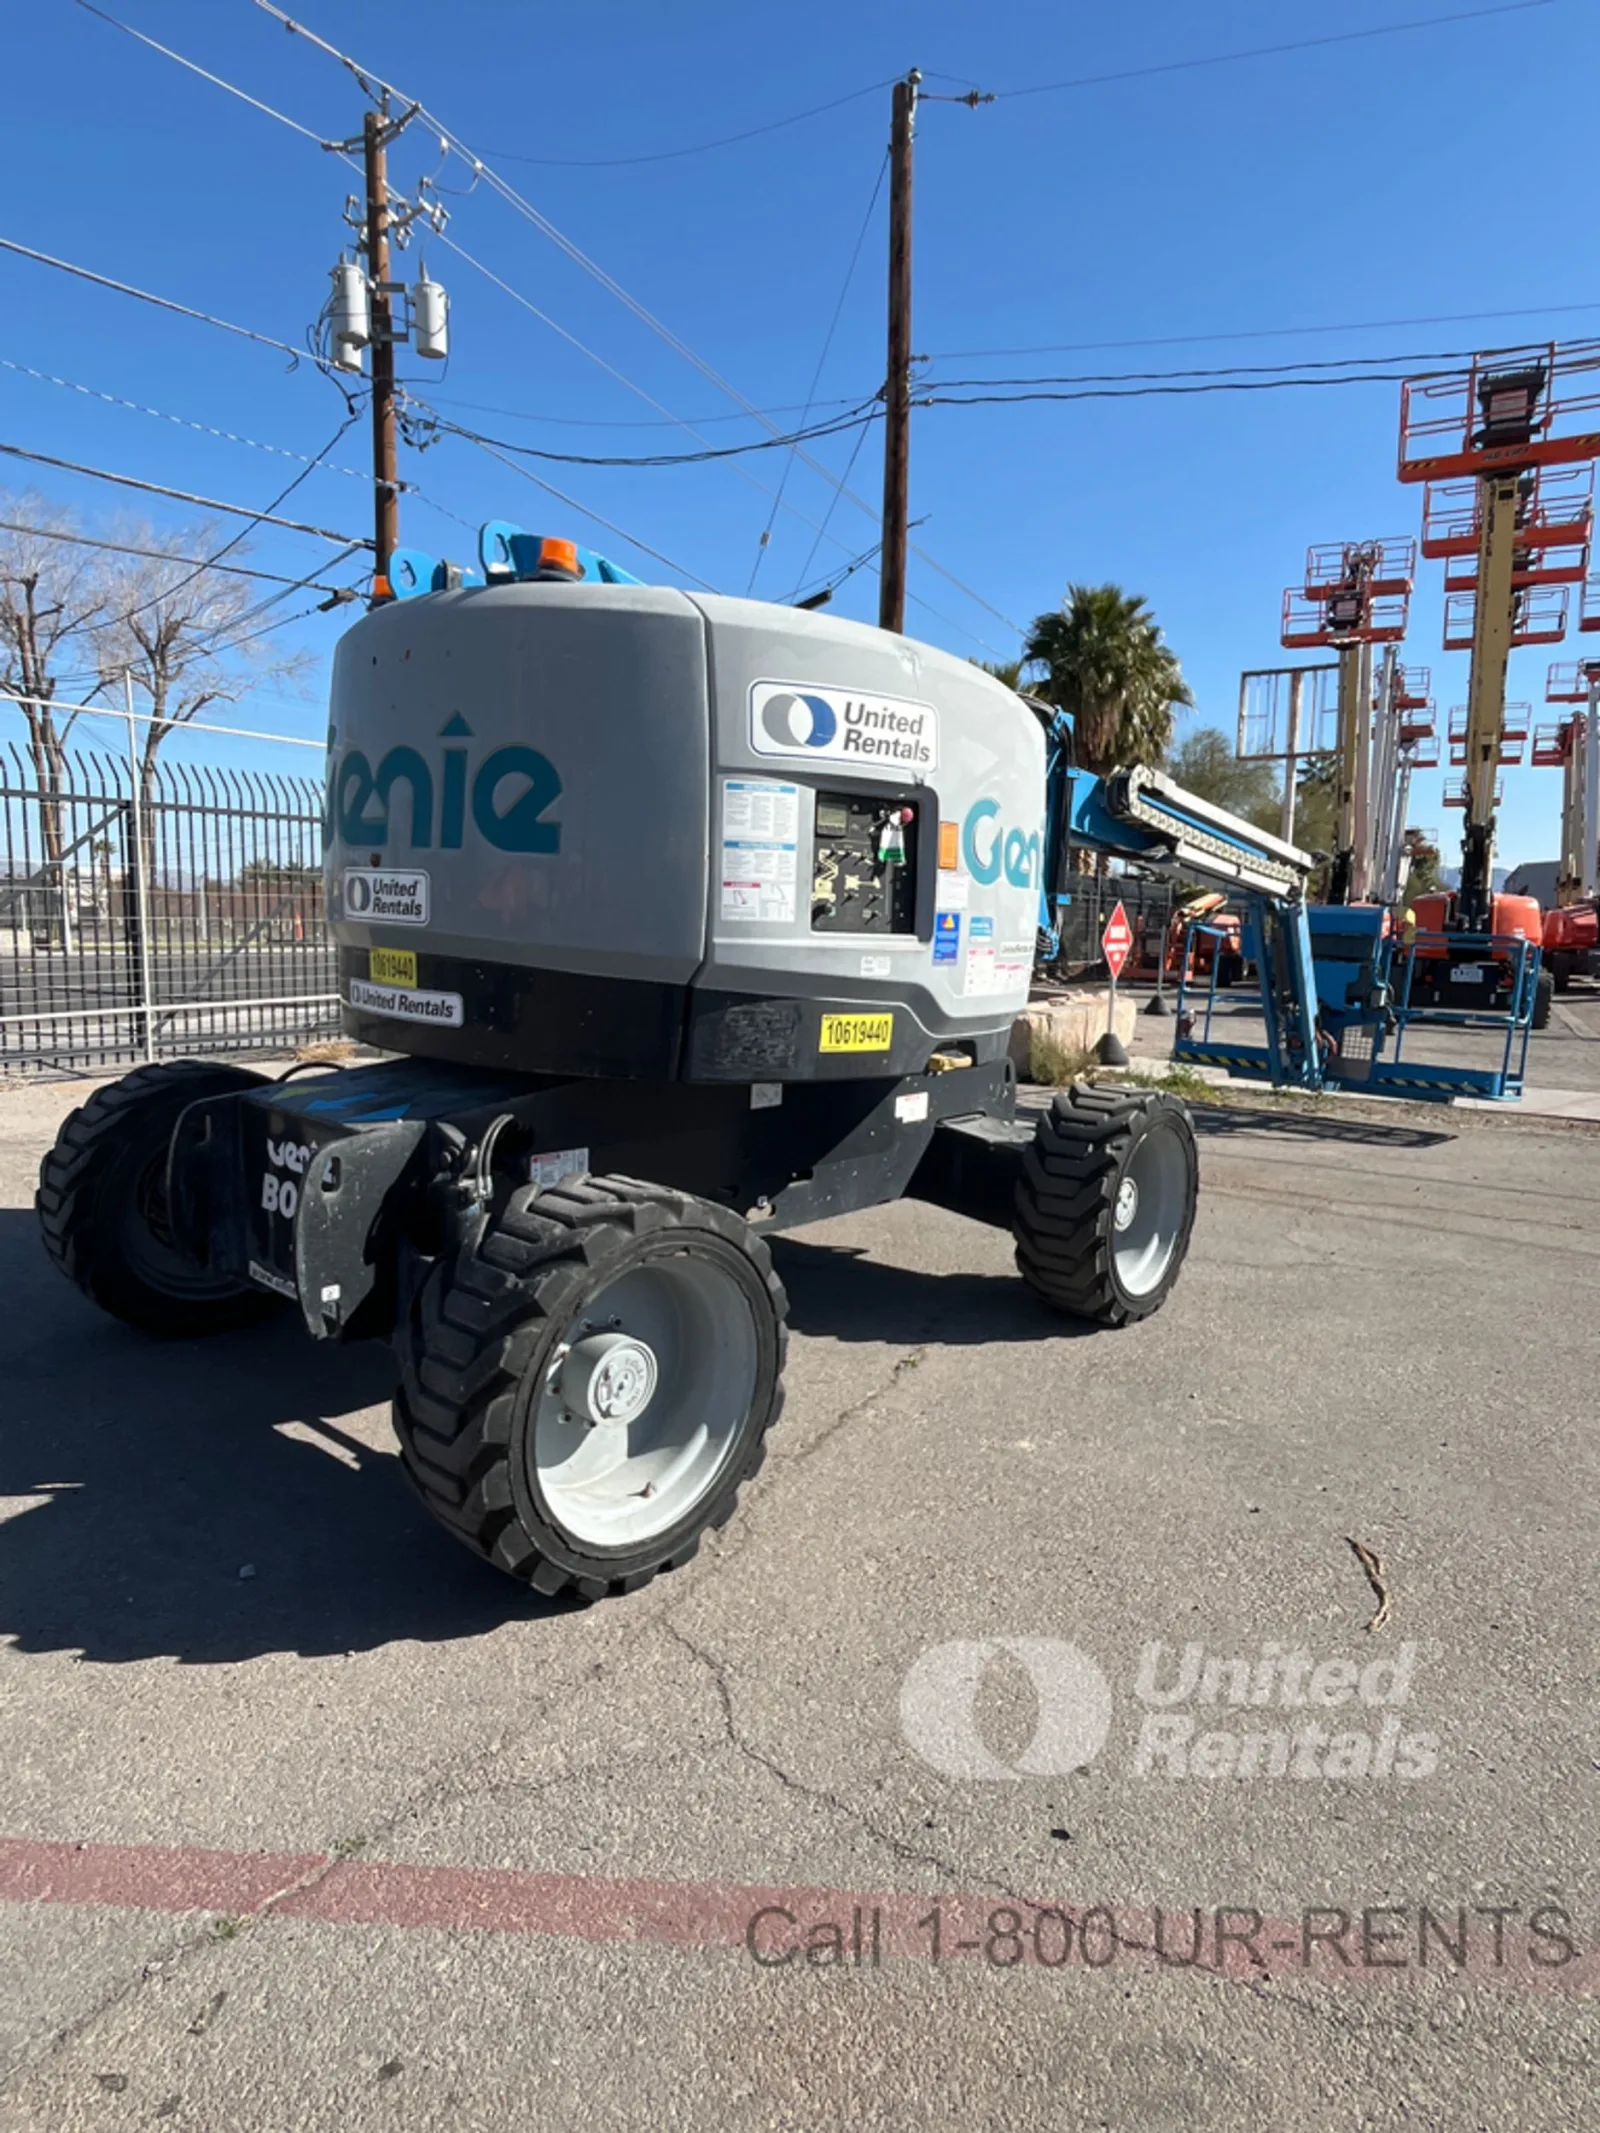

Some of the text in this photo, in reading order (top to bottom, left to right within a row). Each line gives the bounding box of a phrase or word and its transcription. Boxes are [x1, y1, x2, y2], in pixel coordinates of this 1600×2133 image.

[844, 701, 924, 736] United
[843, 727, 931, 762] Rentals
[373, 877, 418, 897] United
[372, 896, 422, 916] Rentals
[371, 952, 414, 980] 10619440
[362, 987, 454, 1018] United Rentals
[827, 1020, 889, 1044] 10619440
